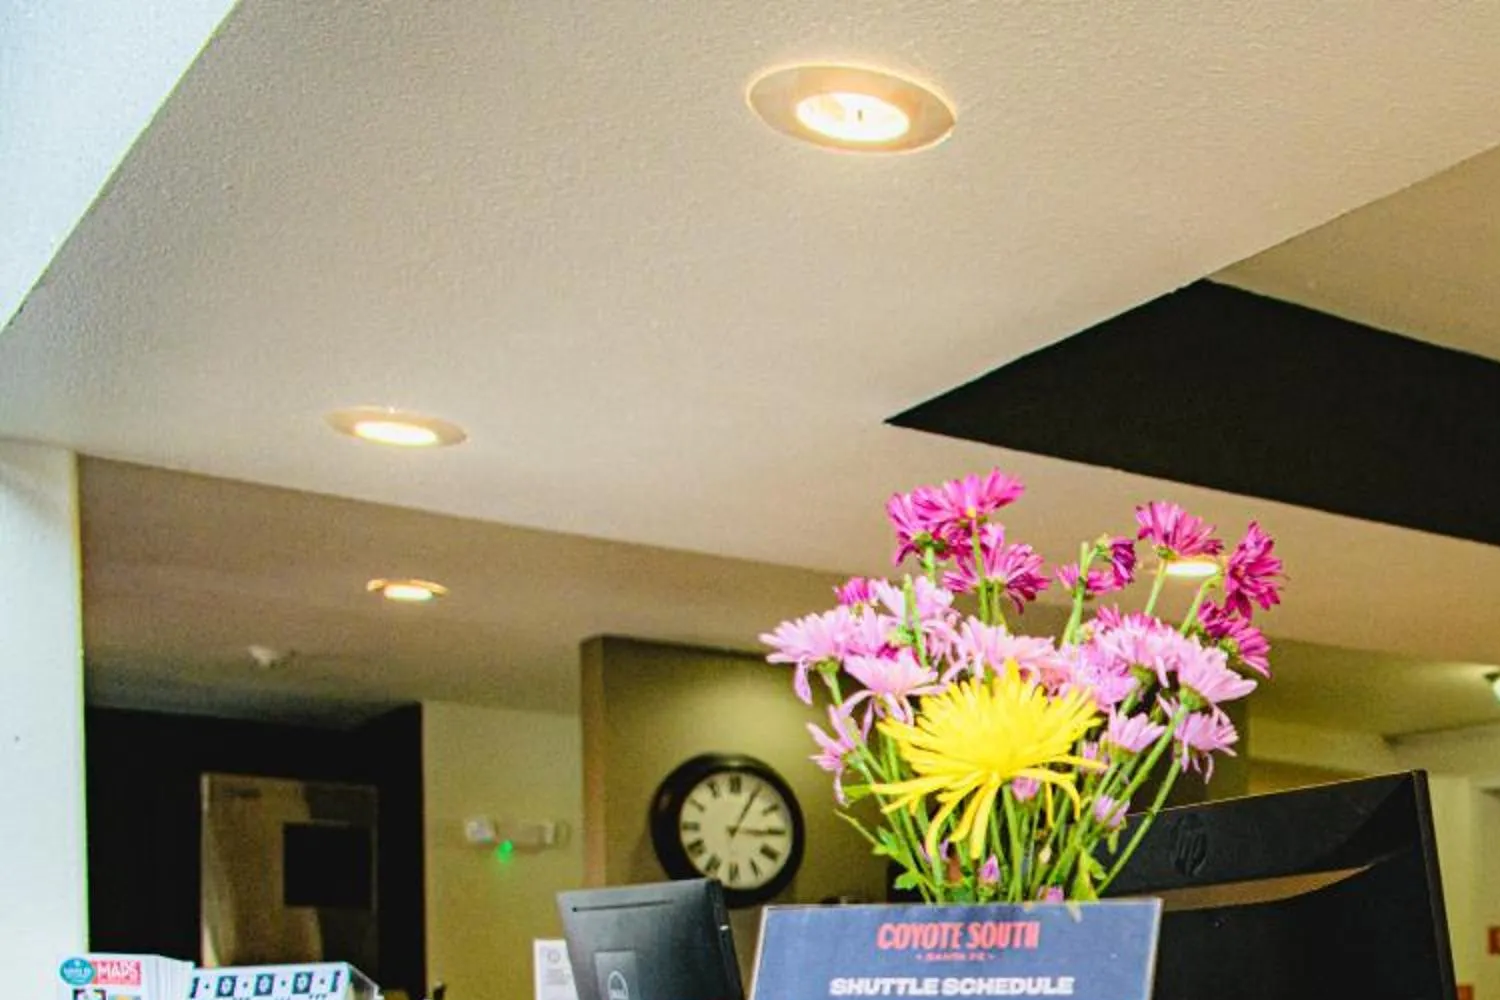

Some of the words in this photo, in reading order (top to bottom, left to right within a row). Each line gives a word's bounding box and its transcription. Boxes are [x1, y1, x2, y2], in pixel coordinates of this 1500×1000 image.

[876, 922, 963, 950] COYOTE
[966, 921, 1041, 949] SOUTH
[829, 977, 939, 997] SHUTTLE
[941, 976, 1075, 996] SCHEDULE
